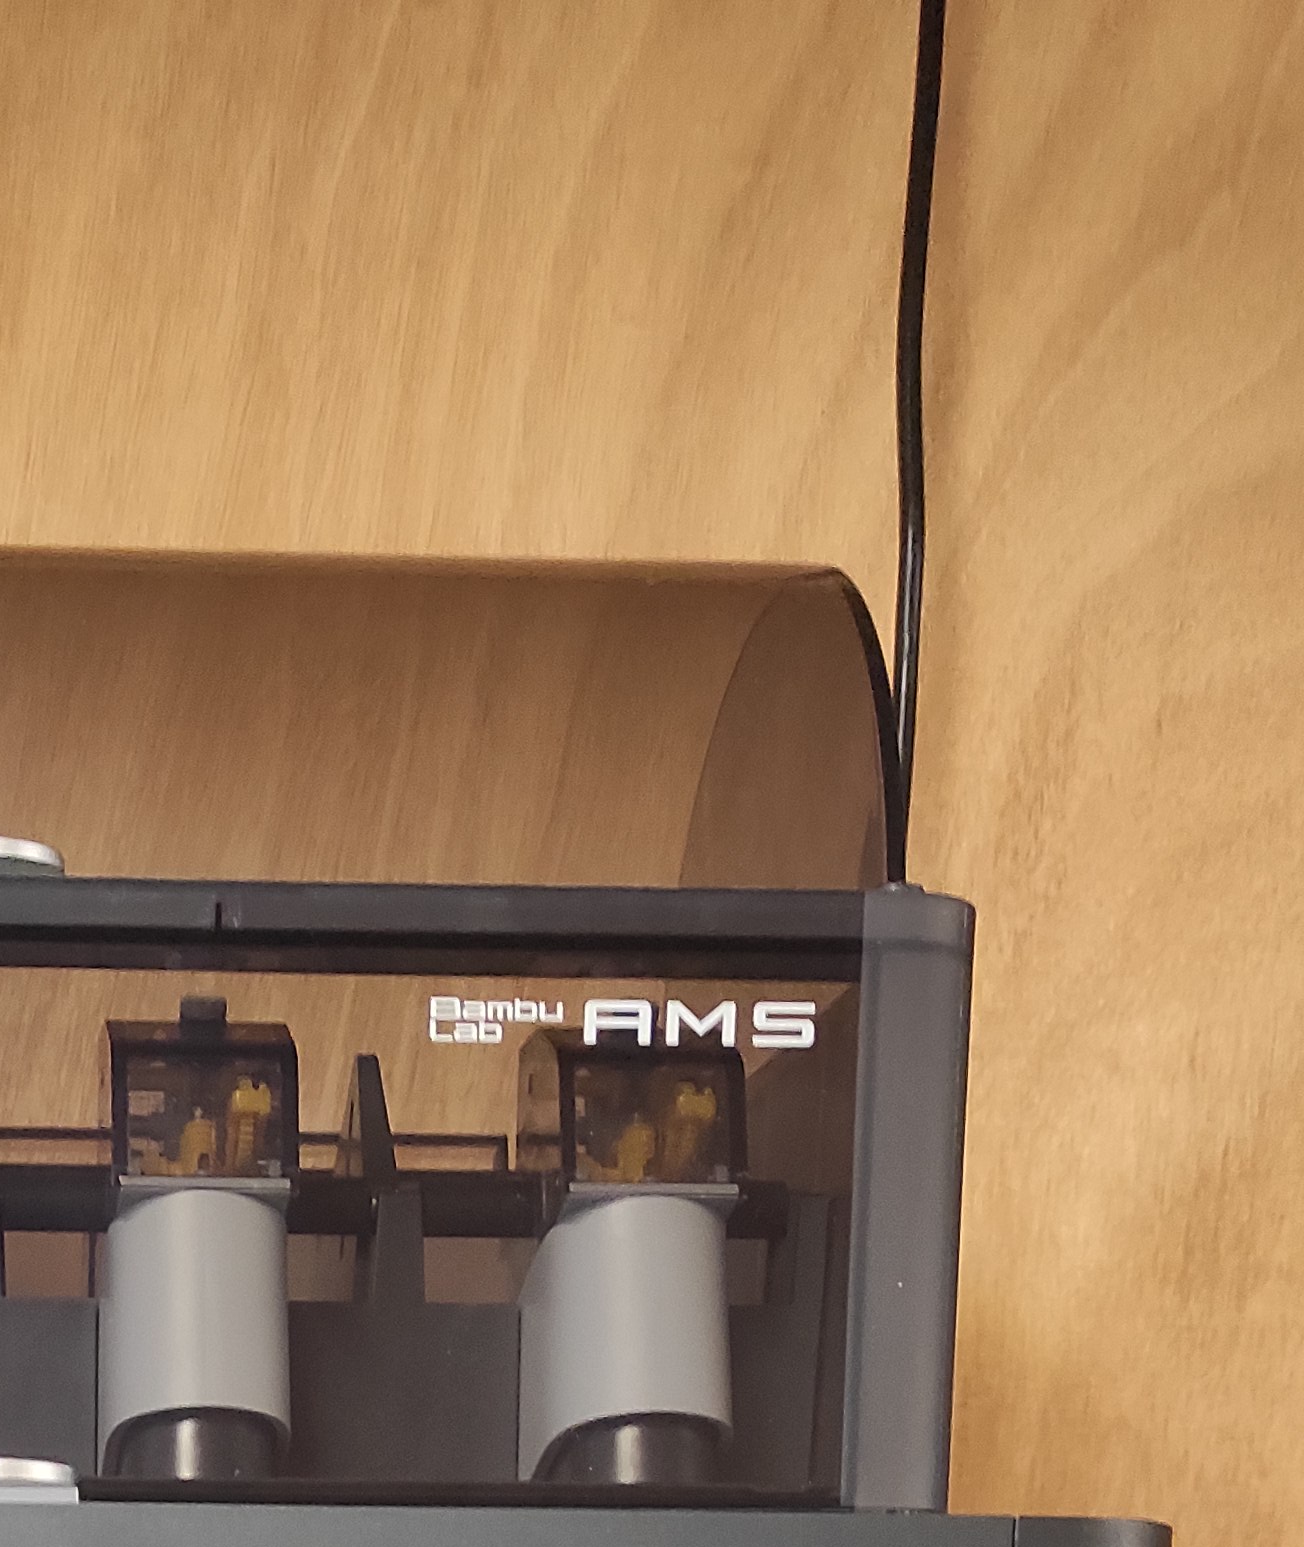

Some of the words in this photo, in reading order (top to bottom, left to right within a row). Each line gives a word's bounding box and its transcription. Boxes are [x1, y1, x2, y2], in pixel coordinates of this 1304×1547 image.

[429, 995, 563, 1023] Bambu
[428, 1018, 503, 1044] Lab
[582, 999, 816, 1049] AMS
